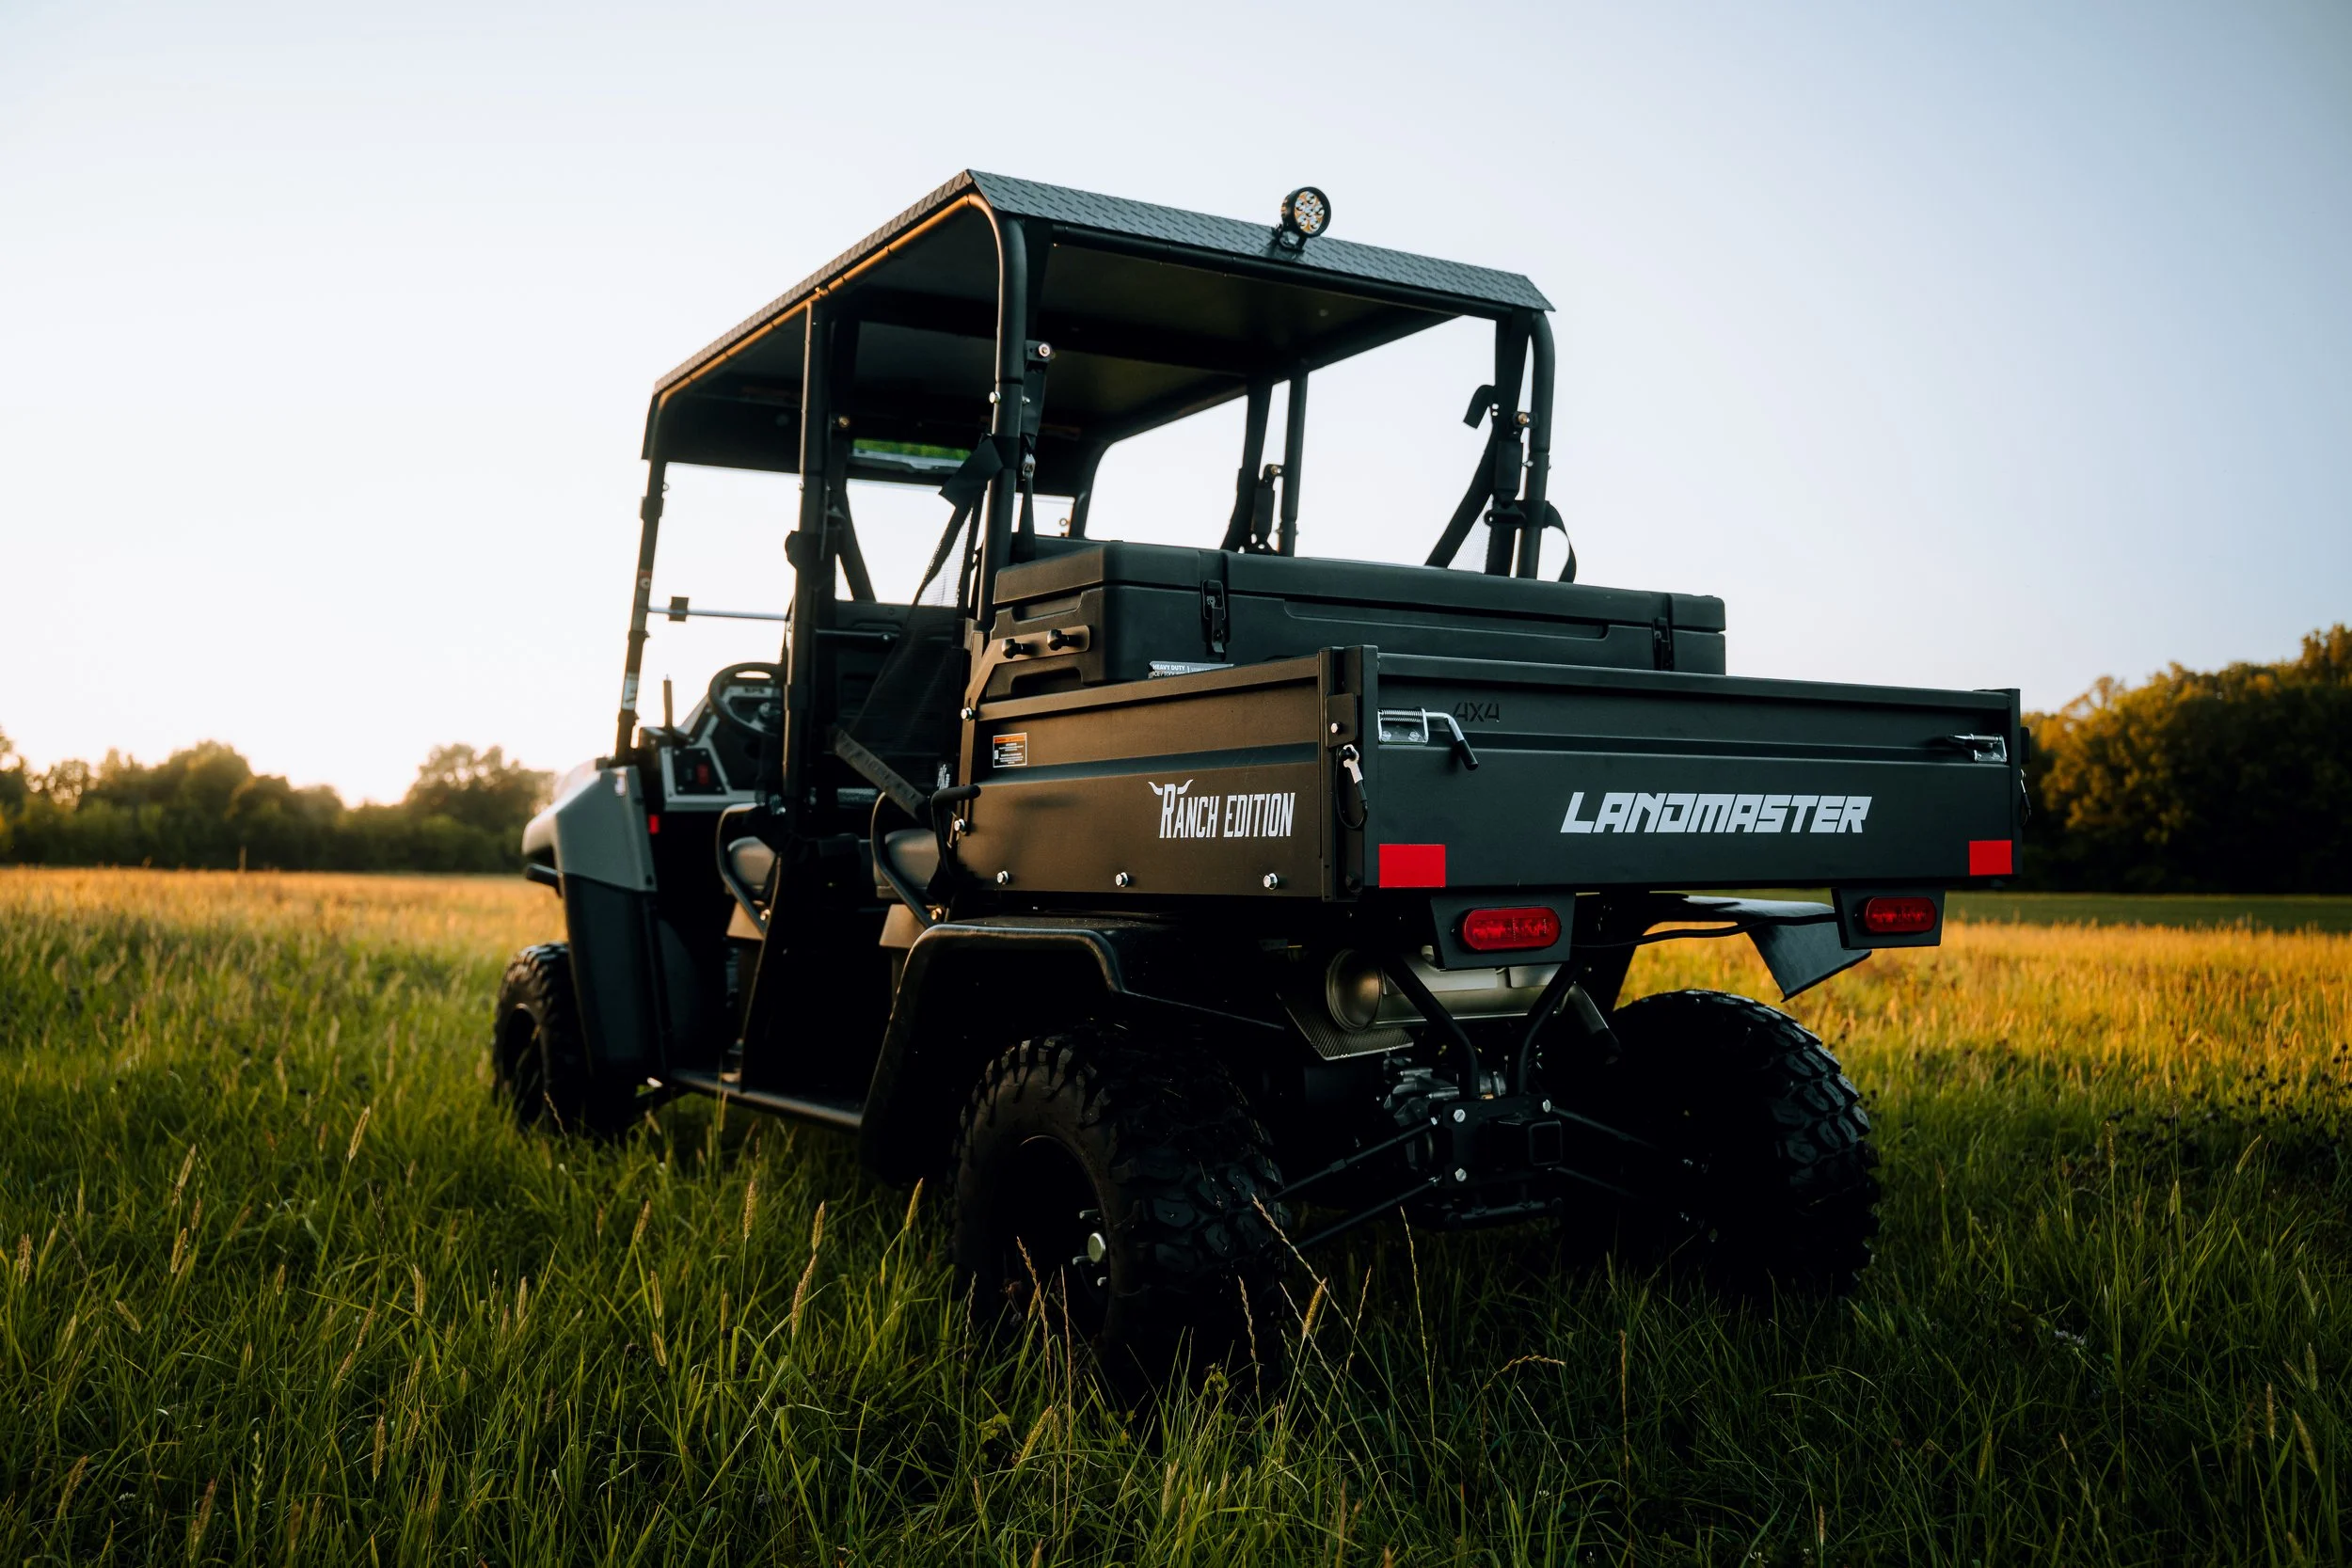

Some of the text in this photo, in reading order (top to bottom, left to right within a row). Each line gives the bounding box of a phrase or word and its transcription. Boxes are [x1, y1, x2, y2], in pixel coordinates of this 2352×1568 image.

[1159, 784, 1296, 839] RANCH EDITION
[1560, 792, 1873, 833] LANDMASTER
